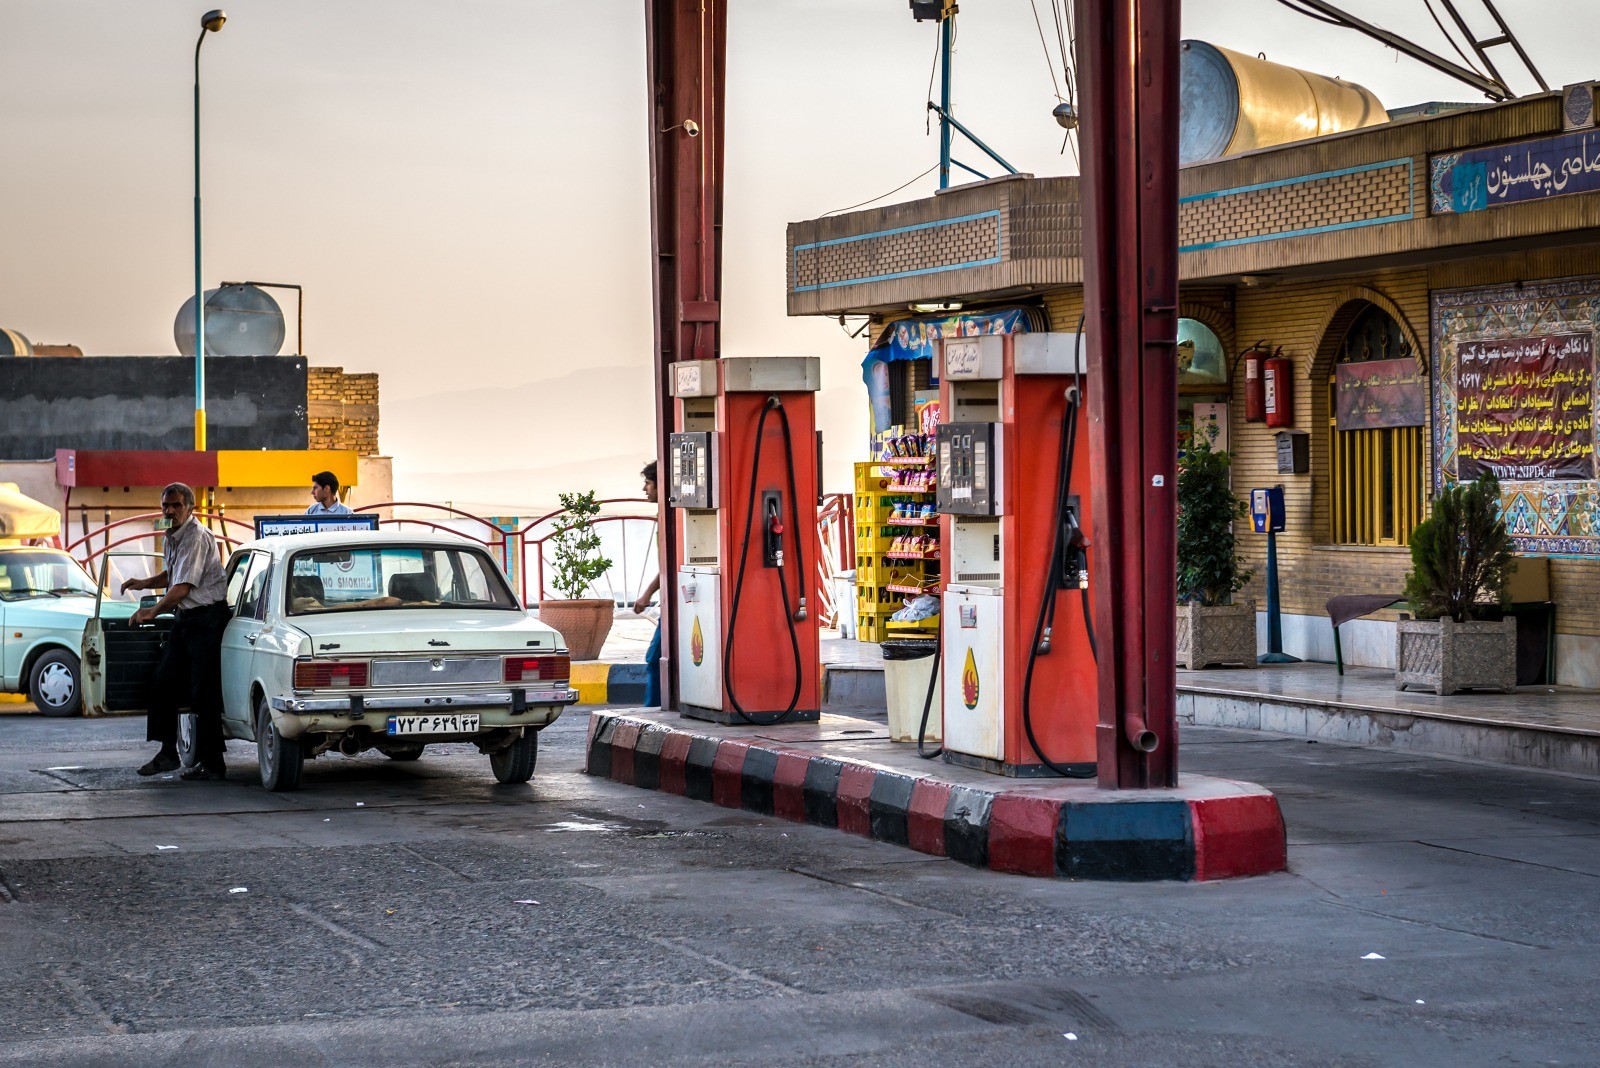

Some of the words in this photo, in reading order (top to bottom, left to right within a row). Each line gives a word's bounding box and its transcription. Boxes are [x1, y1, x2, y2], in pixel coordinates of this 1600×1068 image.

[1487, 150, 1552, 197] چهلستون
[1462, 345, 1476, 365] کنیم
[1478, 344, 1500, 364] مصرف
[1501, 345, 1523, 362] درست
[1525, 338, 1546, 359] آینده
[1548, 343, 1555, 359] به
[1557, 337, 1581, 359] نگاهی
[1583, 337, 1589, 356] با
[1482, 373, 1507, 390] مشتریان
[1514, 371, 1535, 388] ارتباط
[1576, 368, 1592, 386] مرکز
[1458, 396, 1479, 414] نظرات
[1486, 395, 1512, 410] انتقادات
[1521, 393, 1554, 411] پیشنهادات
[1562, 391, 1593, 410] راهنمایی
[1458, 419, 1469, 432] شما
[1471, 419, 1502, 437] پیشنهادات
[1509, 417, 1537, 431] انتقادات
[1538, 415, 1563, 435] دریافت
[1573, 413, 1593, 430] آماده
[1519, 444, 1541, 459] بصورت
[1542, 440, 1564, 459] گرامی
[323, 578, 332, 588] NO
[338, 577, 371, 588] SMOKING
[398, 718, 415, 732] ۷۲
[433, 717, 458, 731] ۶۳۹
[462, 719, 478, 731] ۴۳
